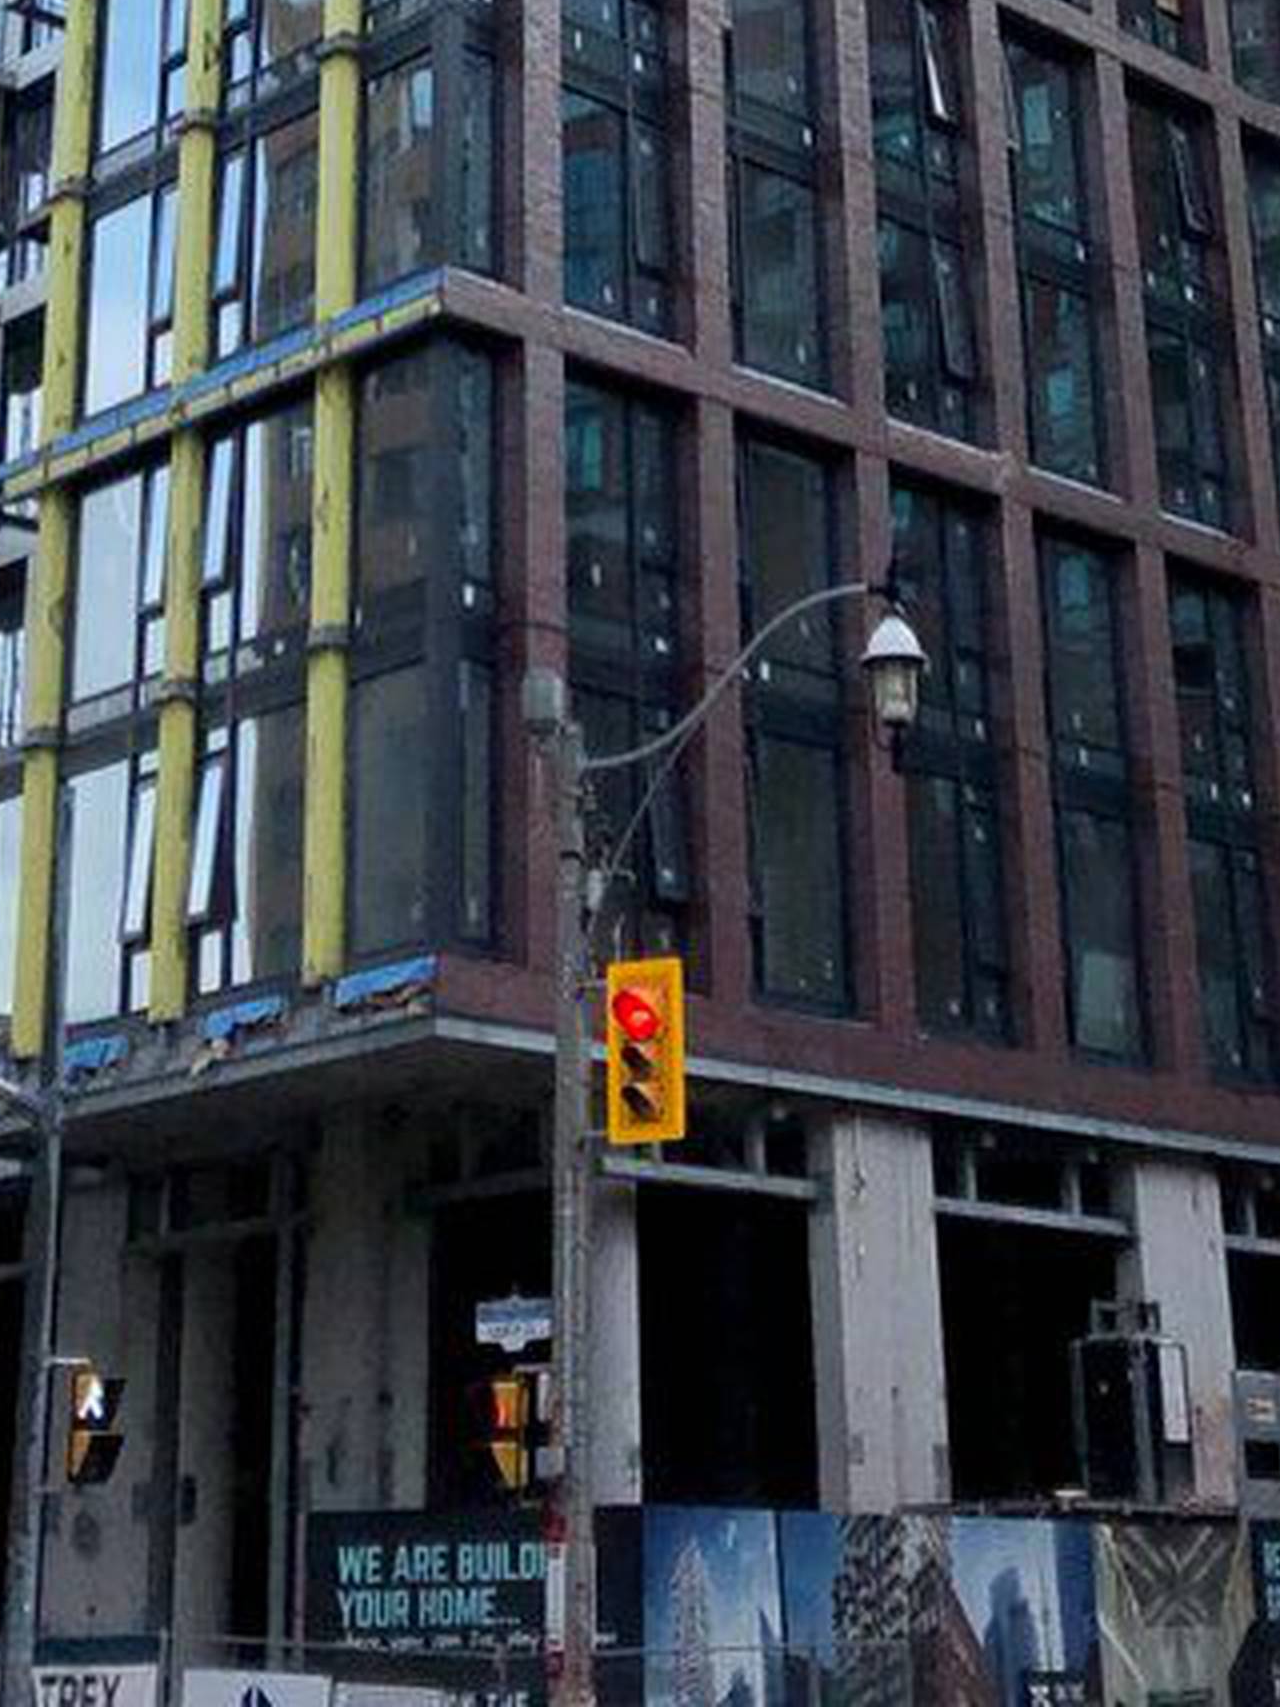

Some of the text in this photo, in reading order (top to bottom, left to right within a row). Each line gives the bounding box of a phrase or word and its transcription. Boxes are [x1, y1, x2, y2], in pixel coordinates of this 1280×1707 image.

[338, 1540, 549, 1583] WE ARE BUILDI
[337, 1589, 410, 1627] YOUR
